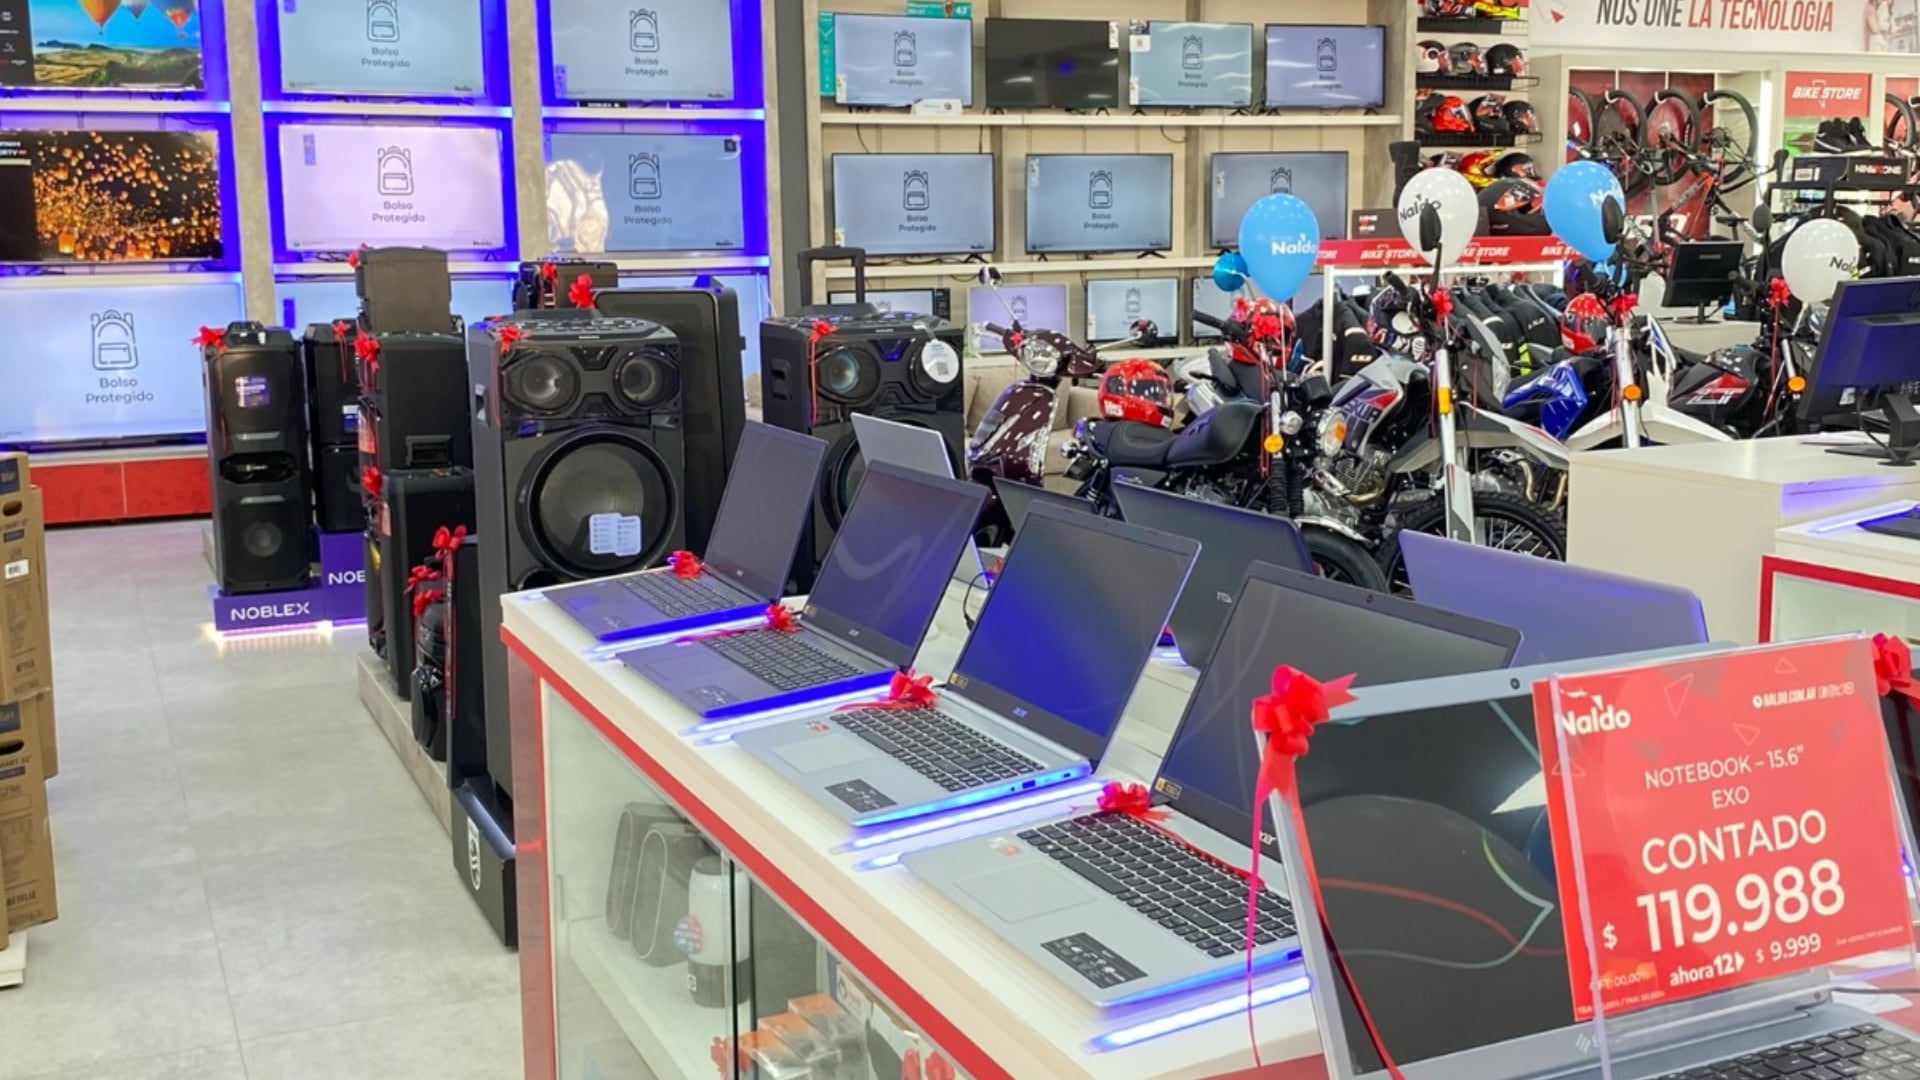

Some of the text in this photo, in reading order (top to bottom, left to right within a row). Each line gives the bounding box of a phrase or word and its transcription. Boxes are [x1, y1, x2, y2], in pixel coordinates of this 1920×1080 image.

[1643, 0, 1683, 27] UNE
[1687, 0, 1712, 28] LA
[372, 47, 399, 56] Bolso
[361, 58, 410, 69] Protegido
[1792, 86, 1862, 99] BIKE STORE
[383, 201, 413, 210] Bolso
[372, 213, 425, 224] Protegido
[1476, 246, 1509, 257] STORE
[100, 377, 138, 388] Bolso
[86, 391, 154, 404] Protegido
[231, 602, 310, 621] NOBLEX
[1645, 755, 1752, 790] NOTEBOOK
[1712, 785, 1750, 809] EXO
[1642, 809, 1827, 874] CONTADO
[1602, 859, 1845, 952] $ 119.988
[1755, 948, 1765, 964] $
[1770, 932, 1821, 962] 9.999
